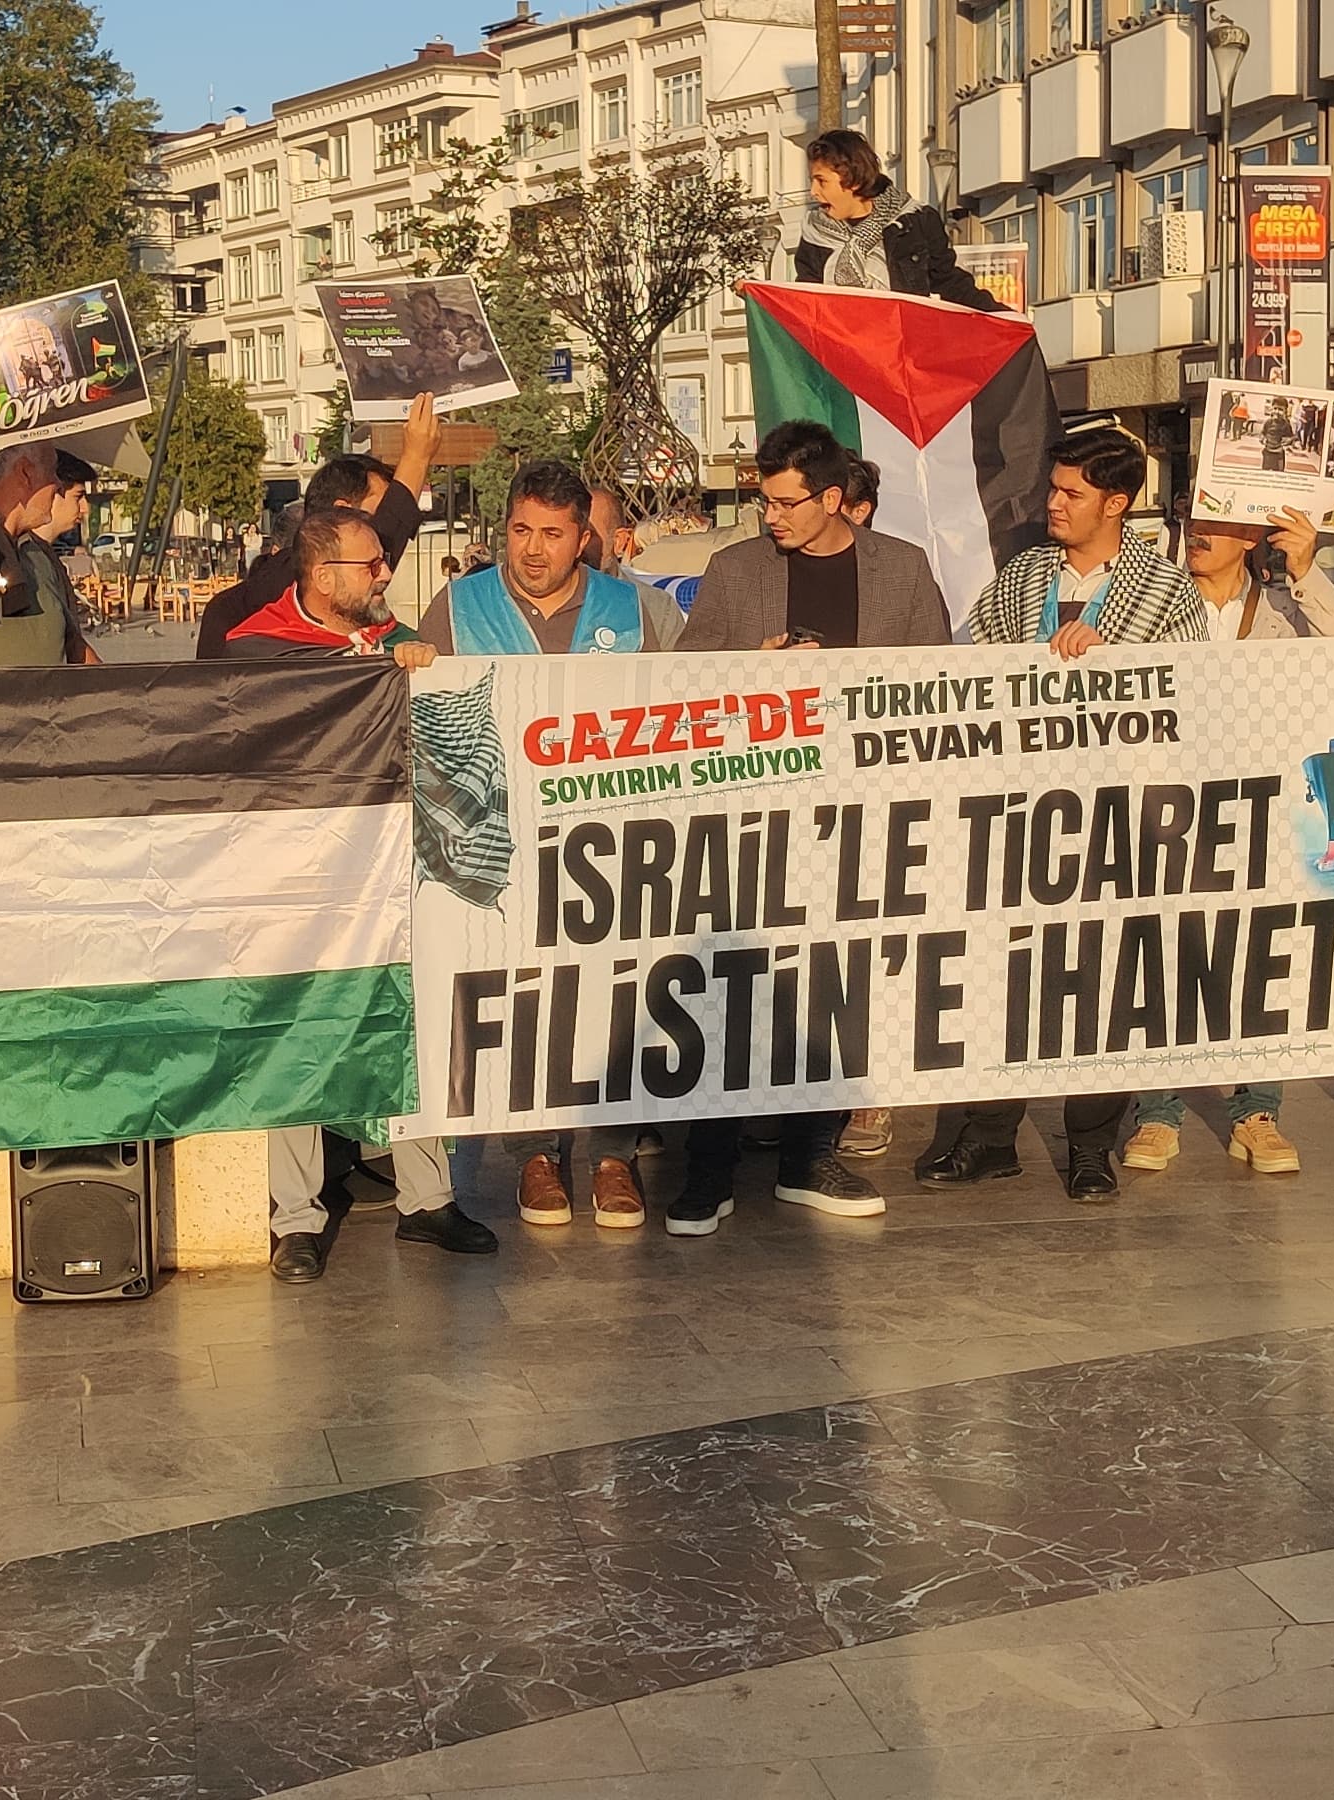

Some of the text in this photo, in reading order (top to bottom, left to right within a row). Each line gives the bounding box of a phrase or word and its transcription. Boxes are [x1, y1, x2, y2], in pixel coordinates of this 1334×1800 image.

[1254, 221, 1321, 238] FIRSAT
[1260, 204, 1317, 221] MEGA
[840, 664, 1176, 721] TÜRKİYE TİCARETE
[522, 686, 825, 767] GAZZE'DE
[851, 705, 1181, 769] DEVAM EDİYOR
[538, 745, 824, 806] SOYKIRIM SÜRÜYOR
[958, 775, 1282, 911] TİCARET
